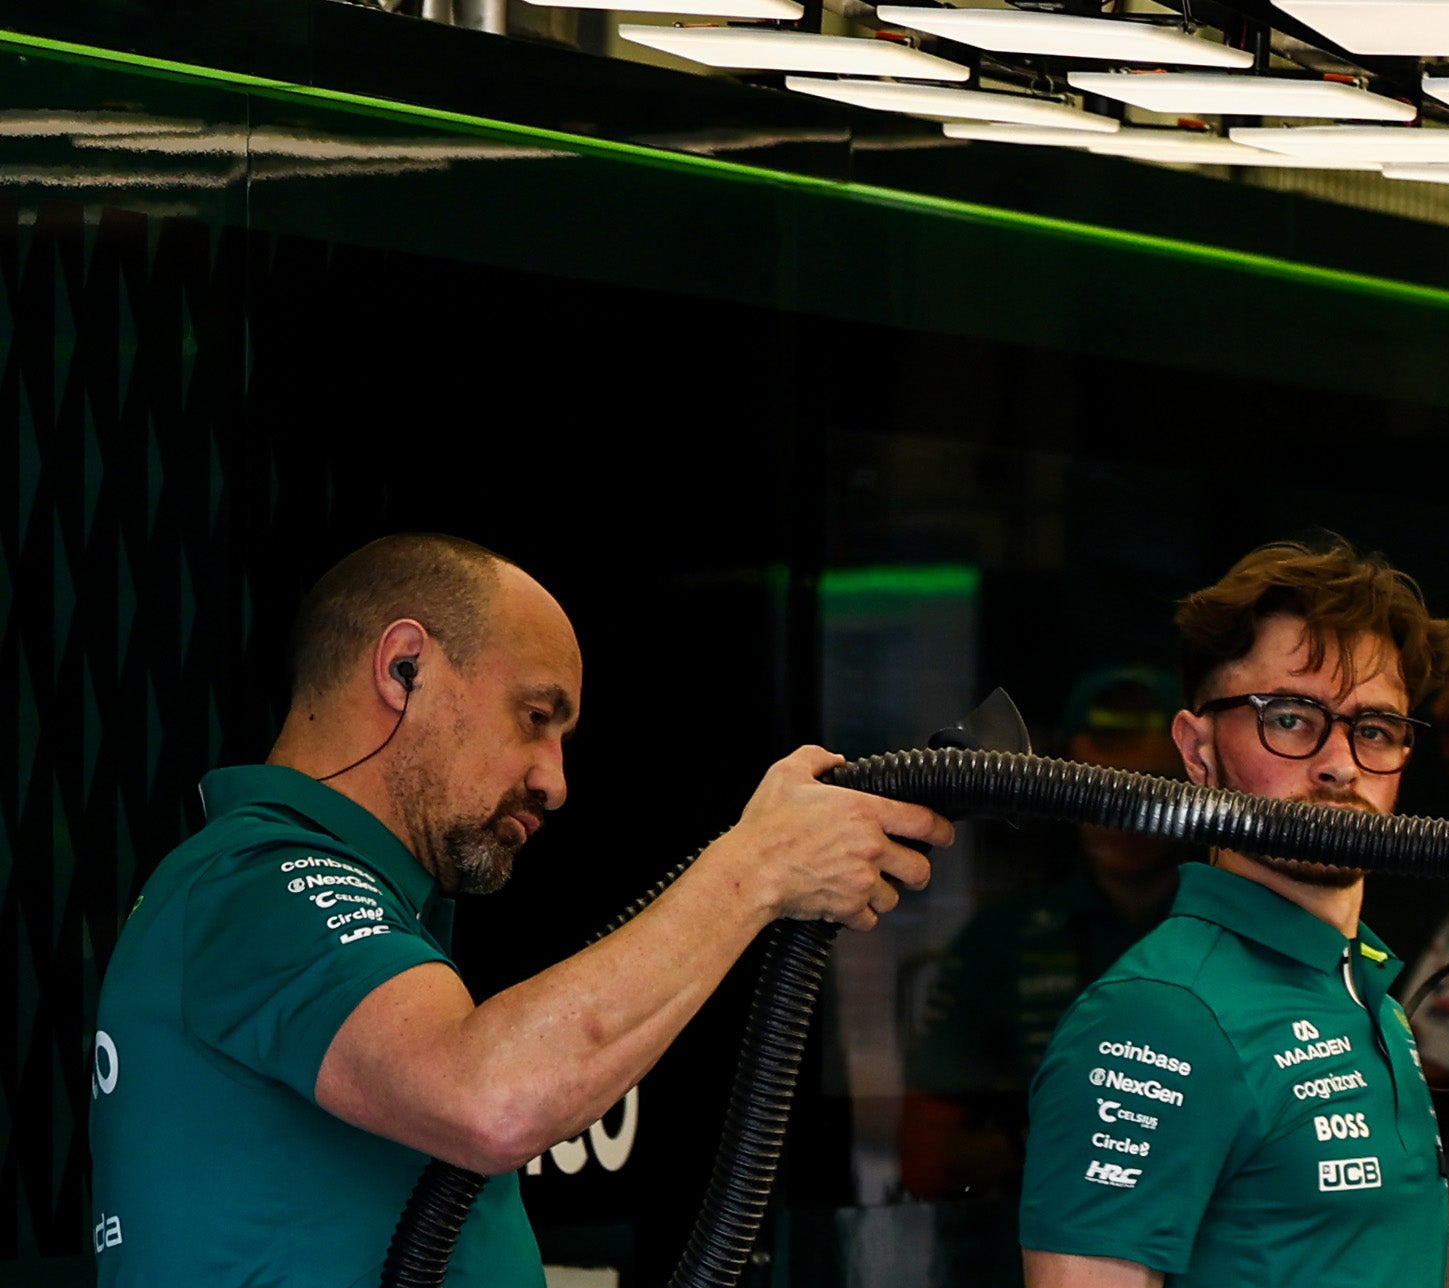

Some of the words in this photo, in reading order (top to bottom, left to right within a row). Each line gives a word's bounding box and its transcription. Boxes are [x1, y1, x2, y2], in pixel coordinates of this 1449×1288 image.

[1098, 1041, 1192, 1077] coinbase
[1273, 1036, 1351, 1069] MAADEN
[1105, 1070, 1185, 1106] NexGen
[1292, 1070, 1368, 1100] cognizant
[1116, 1108, 1159, 1127] CELSIUS
[1313, 1112, 1370, 1141] BOSS
[1085, 1160, 1143, 1185] HRC
[1322, 1161, 1380, 1188] JCB
